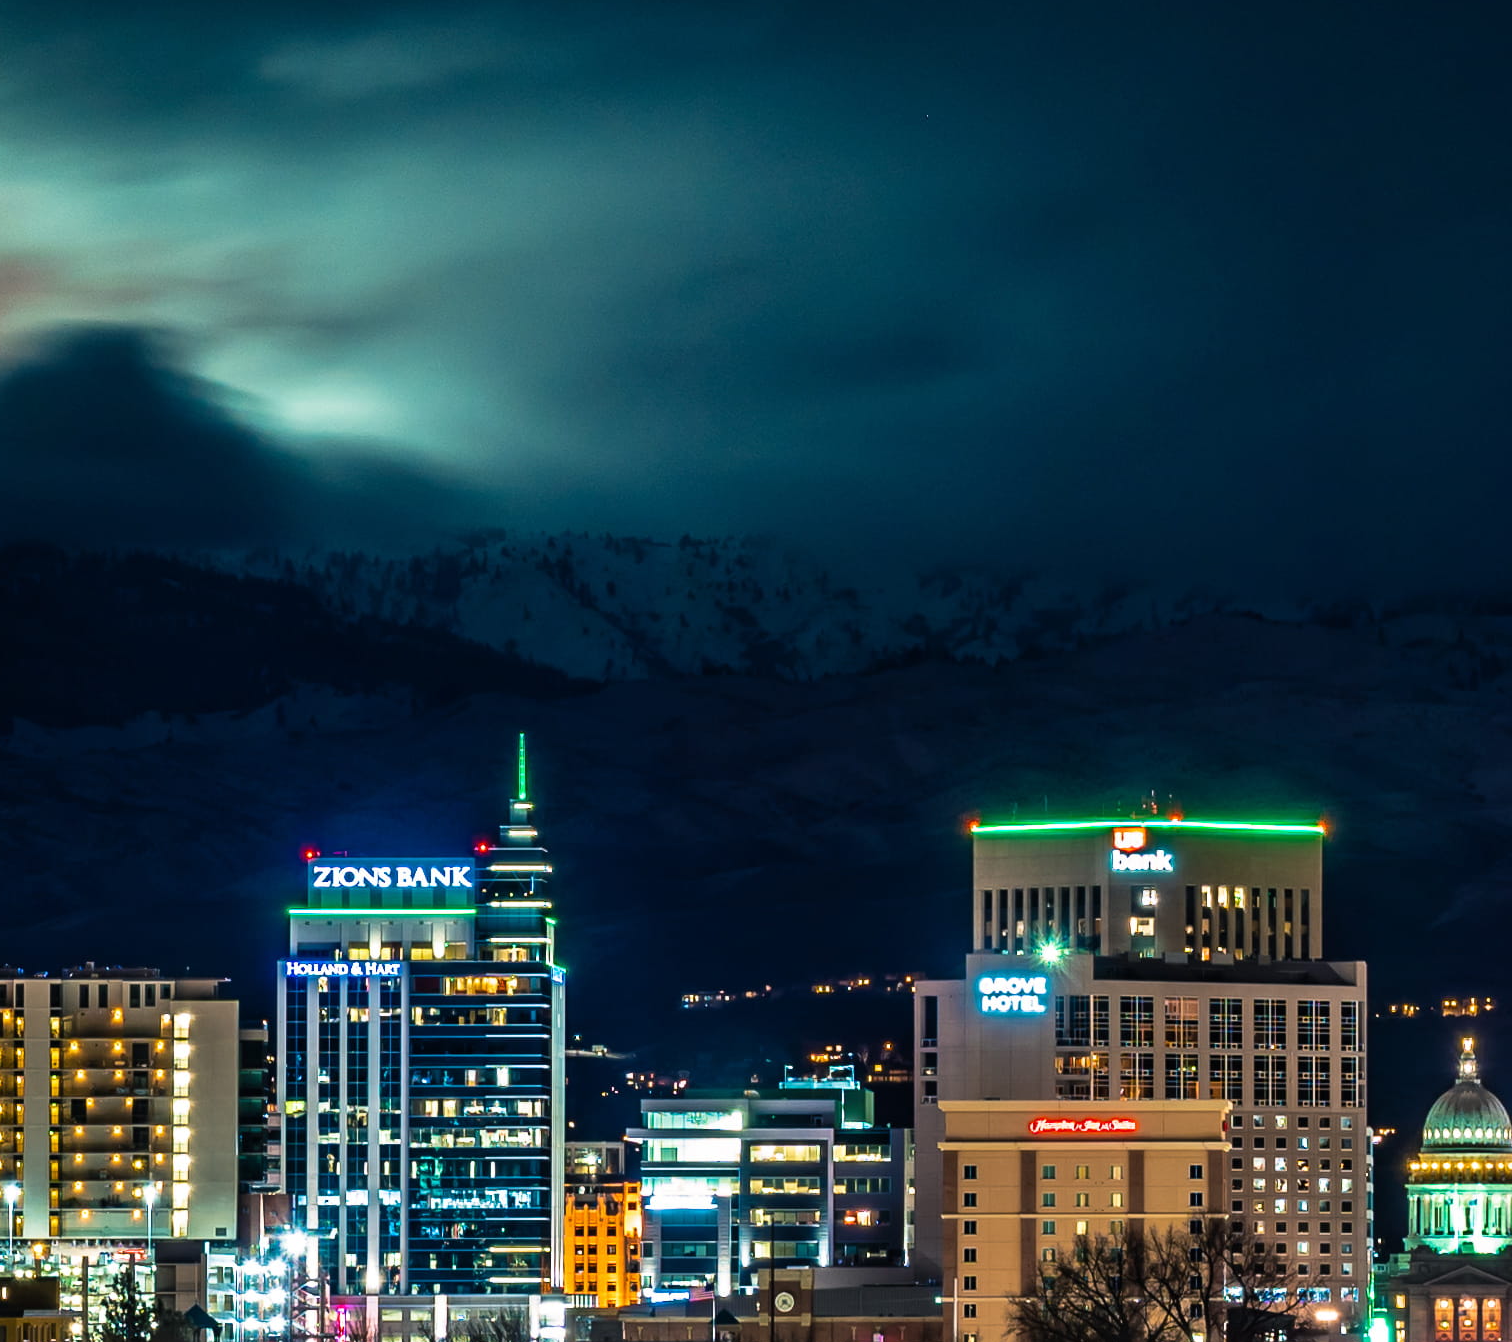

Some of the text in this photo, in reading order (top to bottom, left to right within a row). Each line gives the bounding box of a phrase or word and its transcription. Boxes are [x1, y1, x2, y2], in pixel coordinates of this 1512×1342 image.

[1112, 850, 1173, 871] bank
[313, 866, 472, 887] ZIONS BANK
[286, 961, 400, 976] HOLLAND & HART
[979, 977, 1047, 994] GROVE
[981, 995, 1047, 1012] HOTEL
